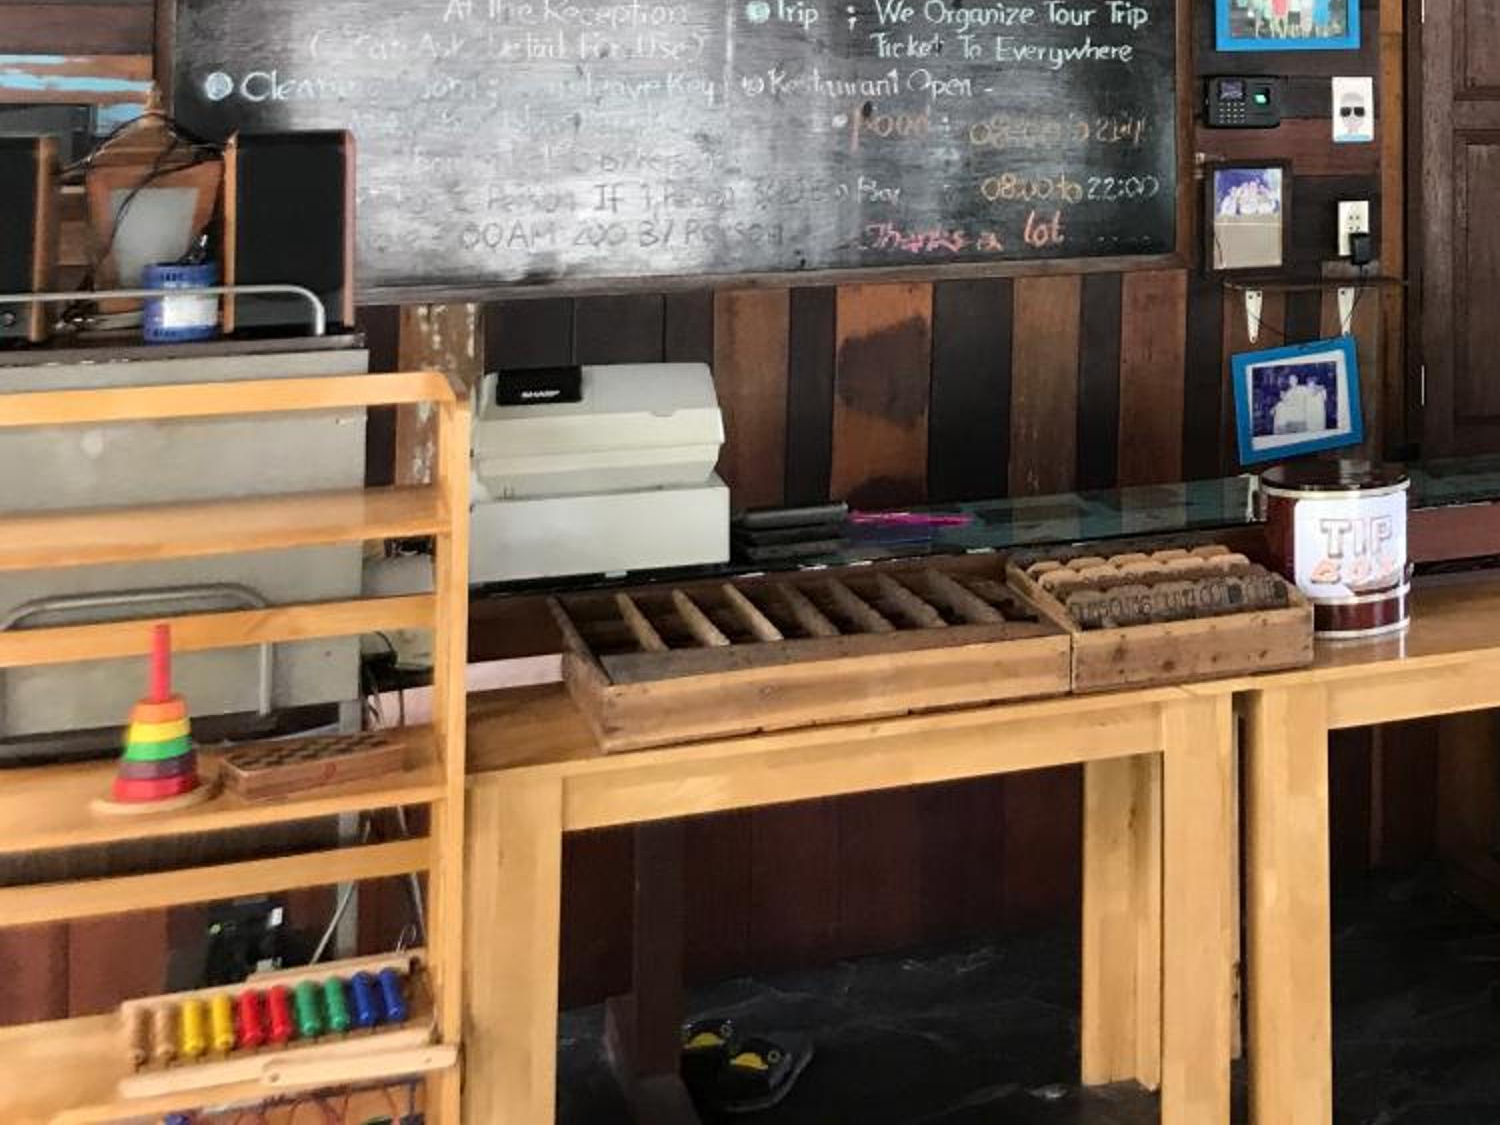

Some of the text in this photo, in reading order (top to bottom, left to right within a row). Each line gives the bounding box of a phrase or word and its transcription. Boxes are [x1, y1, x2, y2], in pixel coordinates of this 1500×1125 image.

[1043, 0, 1097, 26] Tour
[1108, 0, 1151, 30] Trip
[955, 34, 983, 60] To
[995, 35, 1134, 70] Everywhere
[906, 67, 973, 102] Open
[1087, 174, 1161, 201] 22:00
[1318, 513, 1394, 561] TIP
